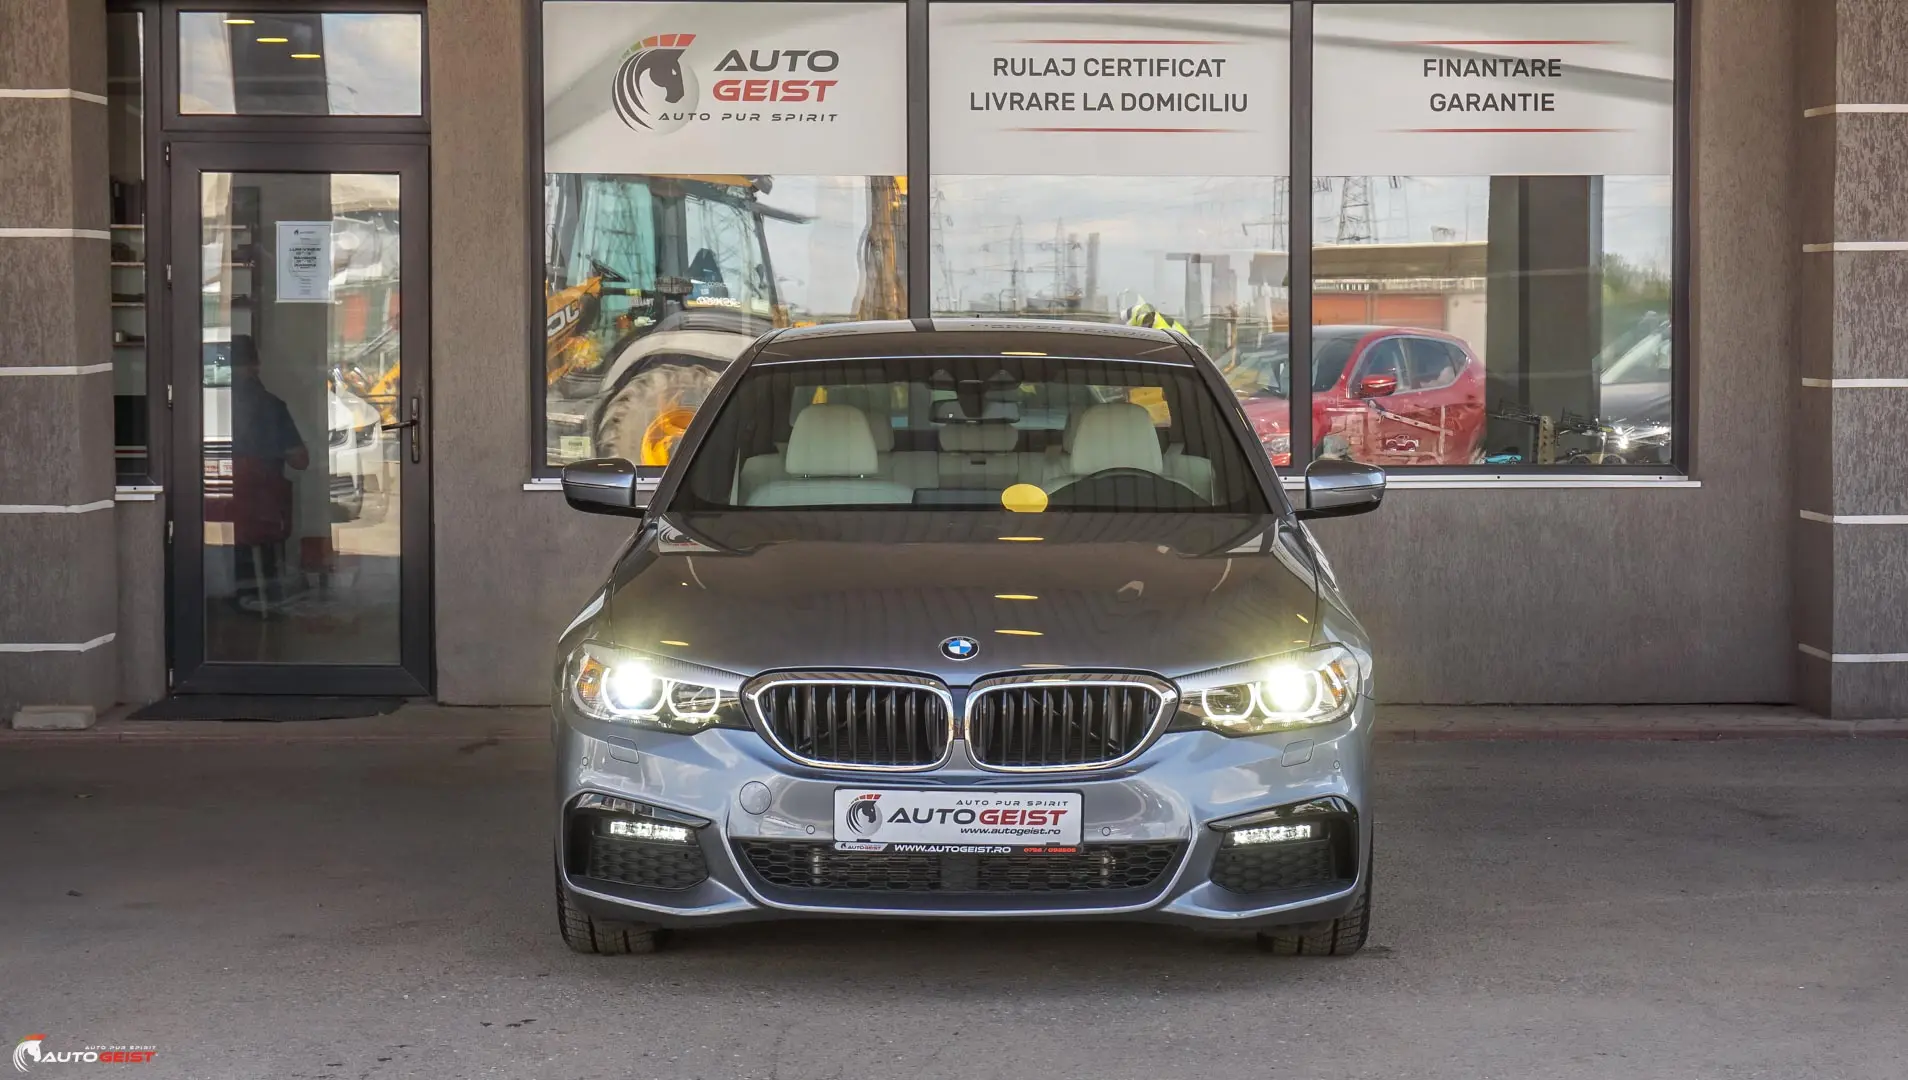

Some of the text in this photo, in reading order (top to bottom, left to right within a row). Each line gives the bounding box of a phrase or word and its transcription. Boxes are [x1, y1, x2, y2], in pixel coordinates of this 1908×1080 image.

[713, 49, 840, 73] AUTO
[993, 57, 1226, 78] RULAJ CERTIFICAT
[1423, 58, 1562, 78] FINANTARE
[712, 79, 839, 103] GEIST
[970, 92, 1249, 113] LIVRARE LA DOMICILIU
[1430, 92, 1556, 112] GARANTIE
[657, 112, 838, 122] AUTO PUR SPIRIT
[955, 799, 989, 807] AUTO
[995, 799, 1021, 807] PUR
[886, 807, 1068, 826] AUTOGEIST
[960, 827, 1061, 837] www.autogeist.ro
[894, 842, 1012, 853] WWW.AUTOGEIST.RO
